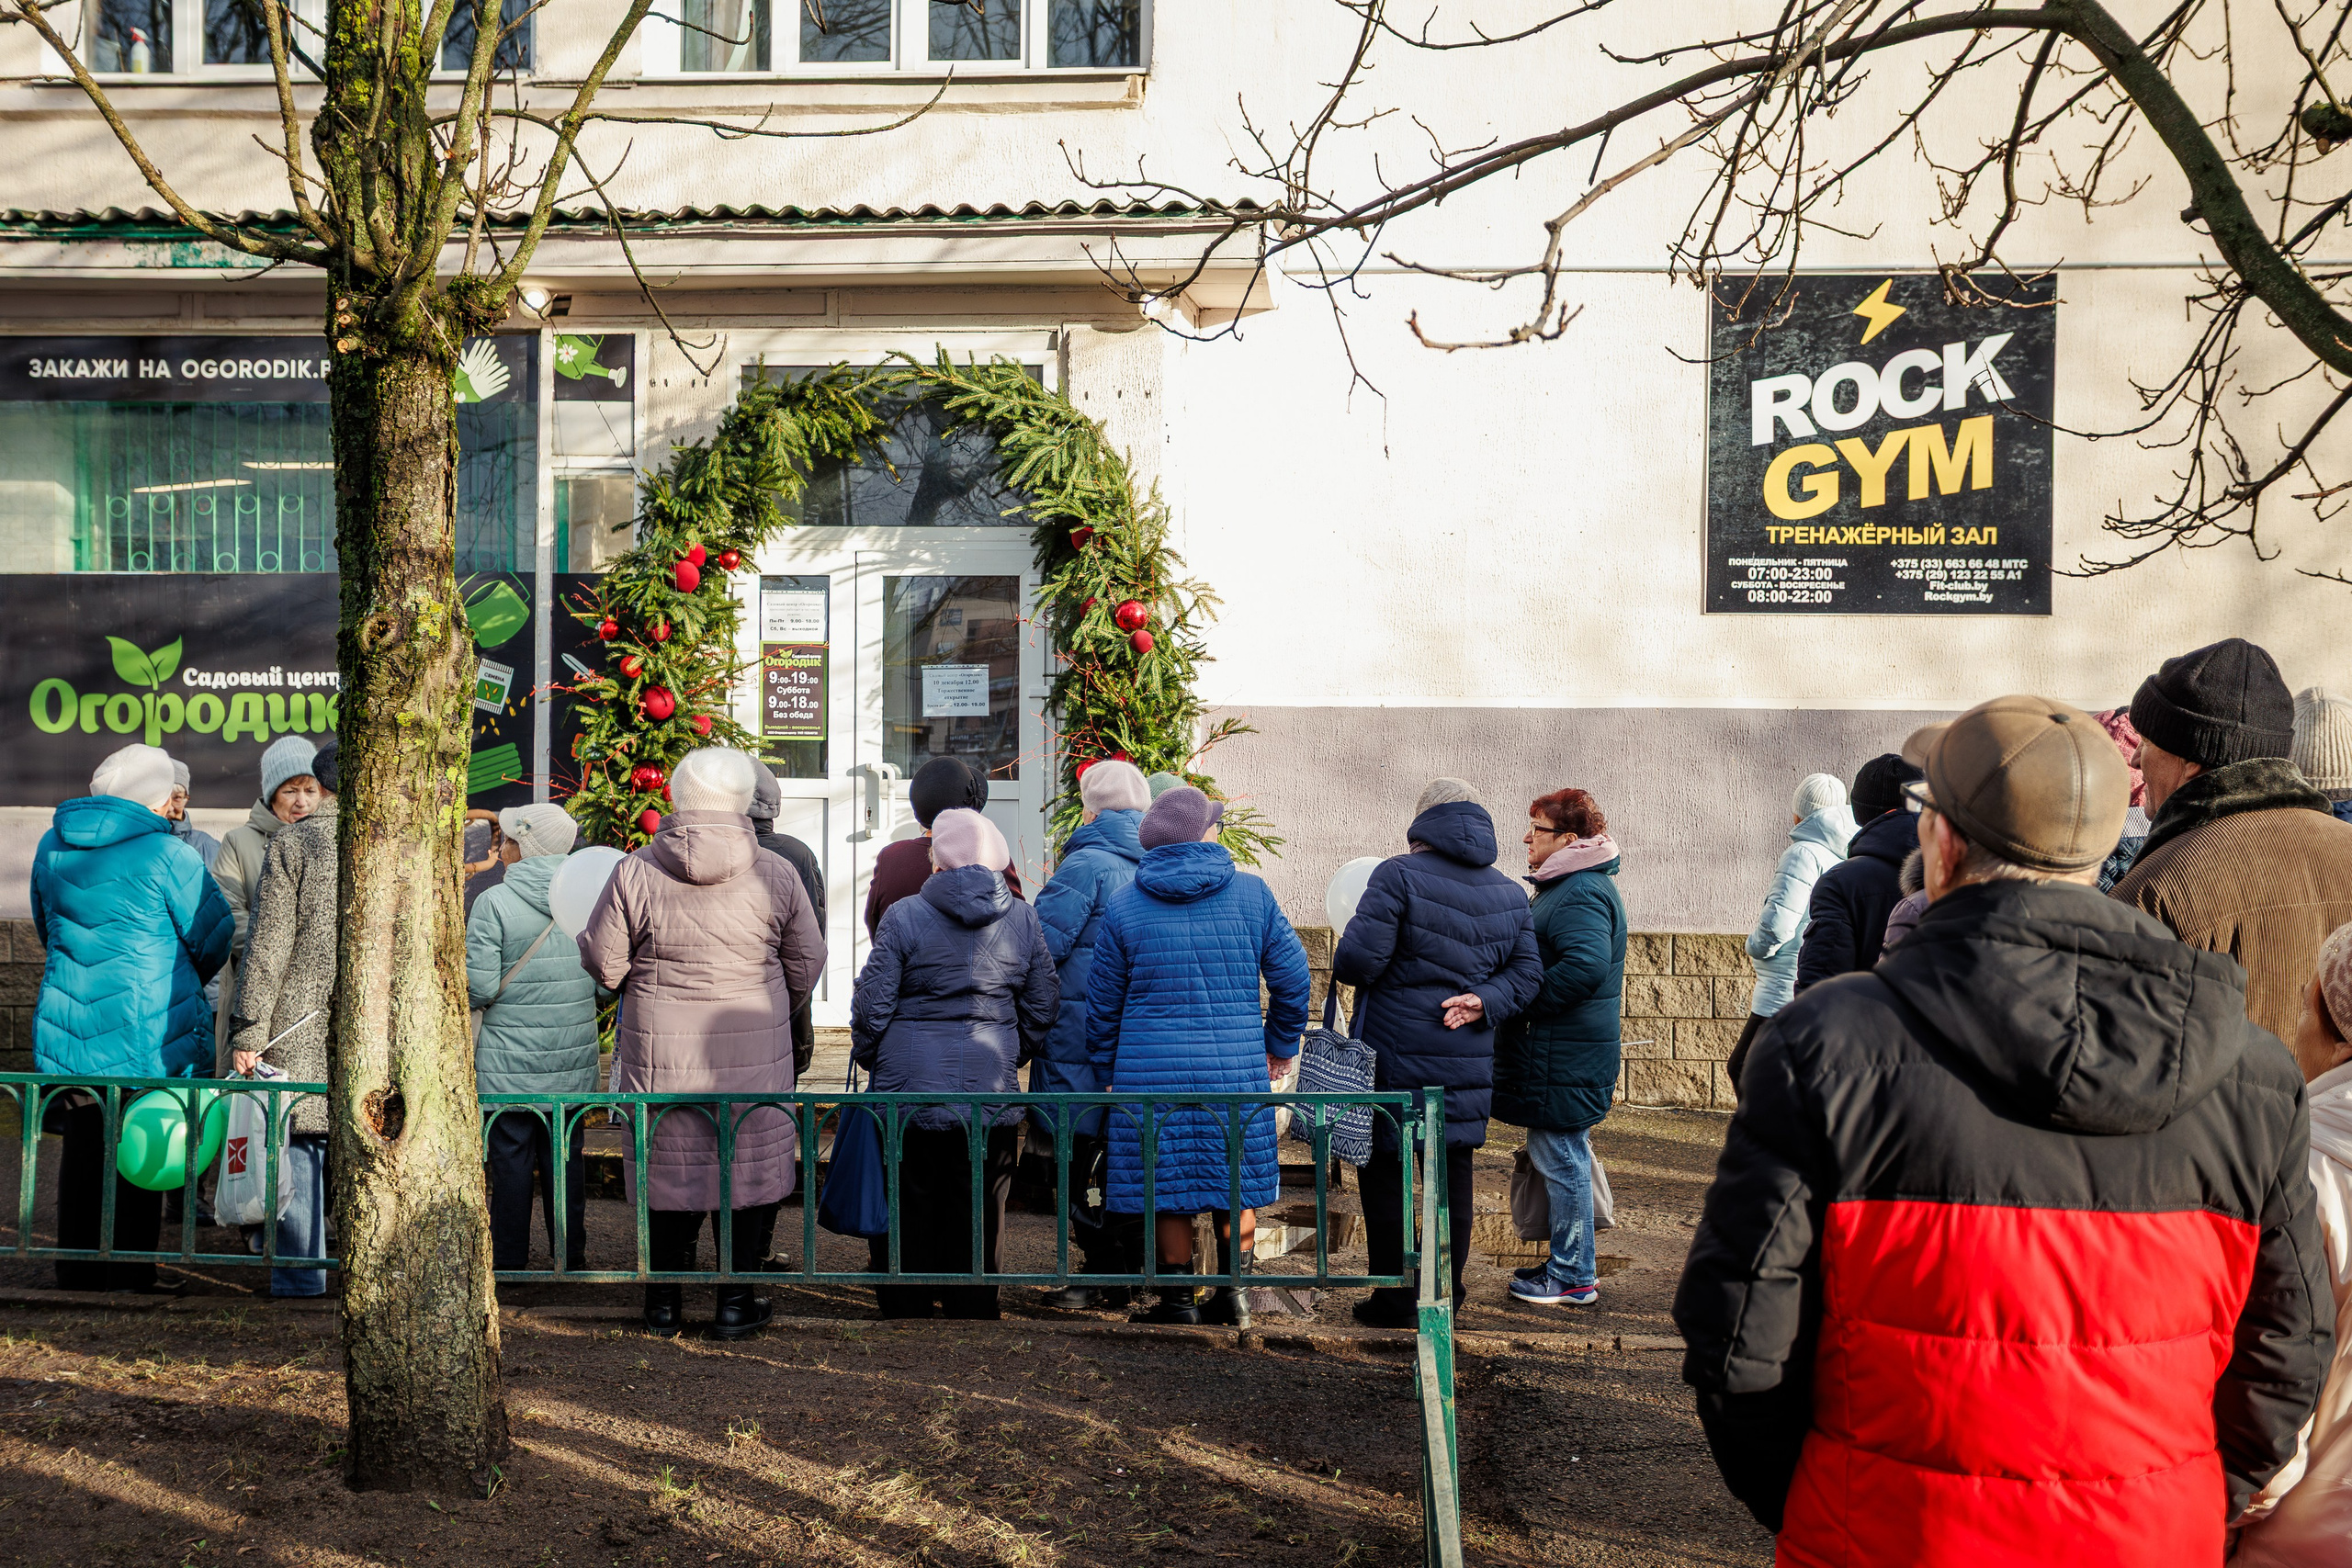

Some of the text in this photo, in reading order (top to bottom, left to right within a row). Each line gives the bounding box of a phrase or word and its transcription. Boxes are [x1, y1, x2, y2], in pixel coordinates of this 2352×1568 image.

[28, 358, 129, 378] ЗАКАЖИ
[139, 359, 173, 378] НА
[1750, 331, 2017, 446] ROCK
[1762, 413, 1995, 521] GYM
[1765, 522, 1998, 545] ТРЕНАЖЁРНЫЙ ЗАЛ
[1728, 558, 1797, 567] ПОНЕДЕЛЬНИК
[1803, 558, 1849, 568] ПЯТНИЦА
[1890, 558, 1919, 569] +375
[1920, 558, 1943, 570] (33)
[1944, 558, 1967, 569] 663
[1967, 558, 1984, 569] 66
[1984, 558, 2000, 569] 48
[1747, 567, 1833, 581] 07:00-23:00
[1894, 570, 1924, 580] +375
[1925, 570, 1948, 581] (29)
[1950, 570, 1972, 580] 123
[1973, 570, 1988, 580] 22
[1989, 570, 2005, 580] 55
[1928, 581, 1989, 592] Fit-club.by
[1747, 590, 1833, 603] 08:00-22:00
[1924, 592, 1994, 604] Rockgym.by
[764, 655, 821, 670] Огородик
[183, 666, 283, 689] Садовый
[483, 671, 505, 682] СЕМЕНА
[769, 671, 819, 684] 9:00-19:00
[776, 685, 810, 695] Суббота
[768, 695, 819, 709] 9.00-18.00
[28, 677, 338, 748] Огородик
[773, 710, 814, 719] Без обеда
